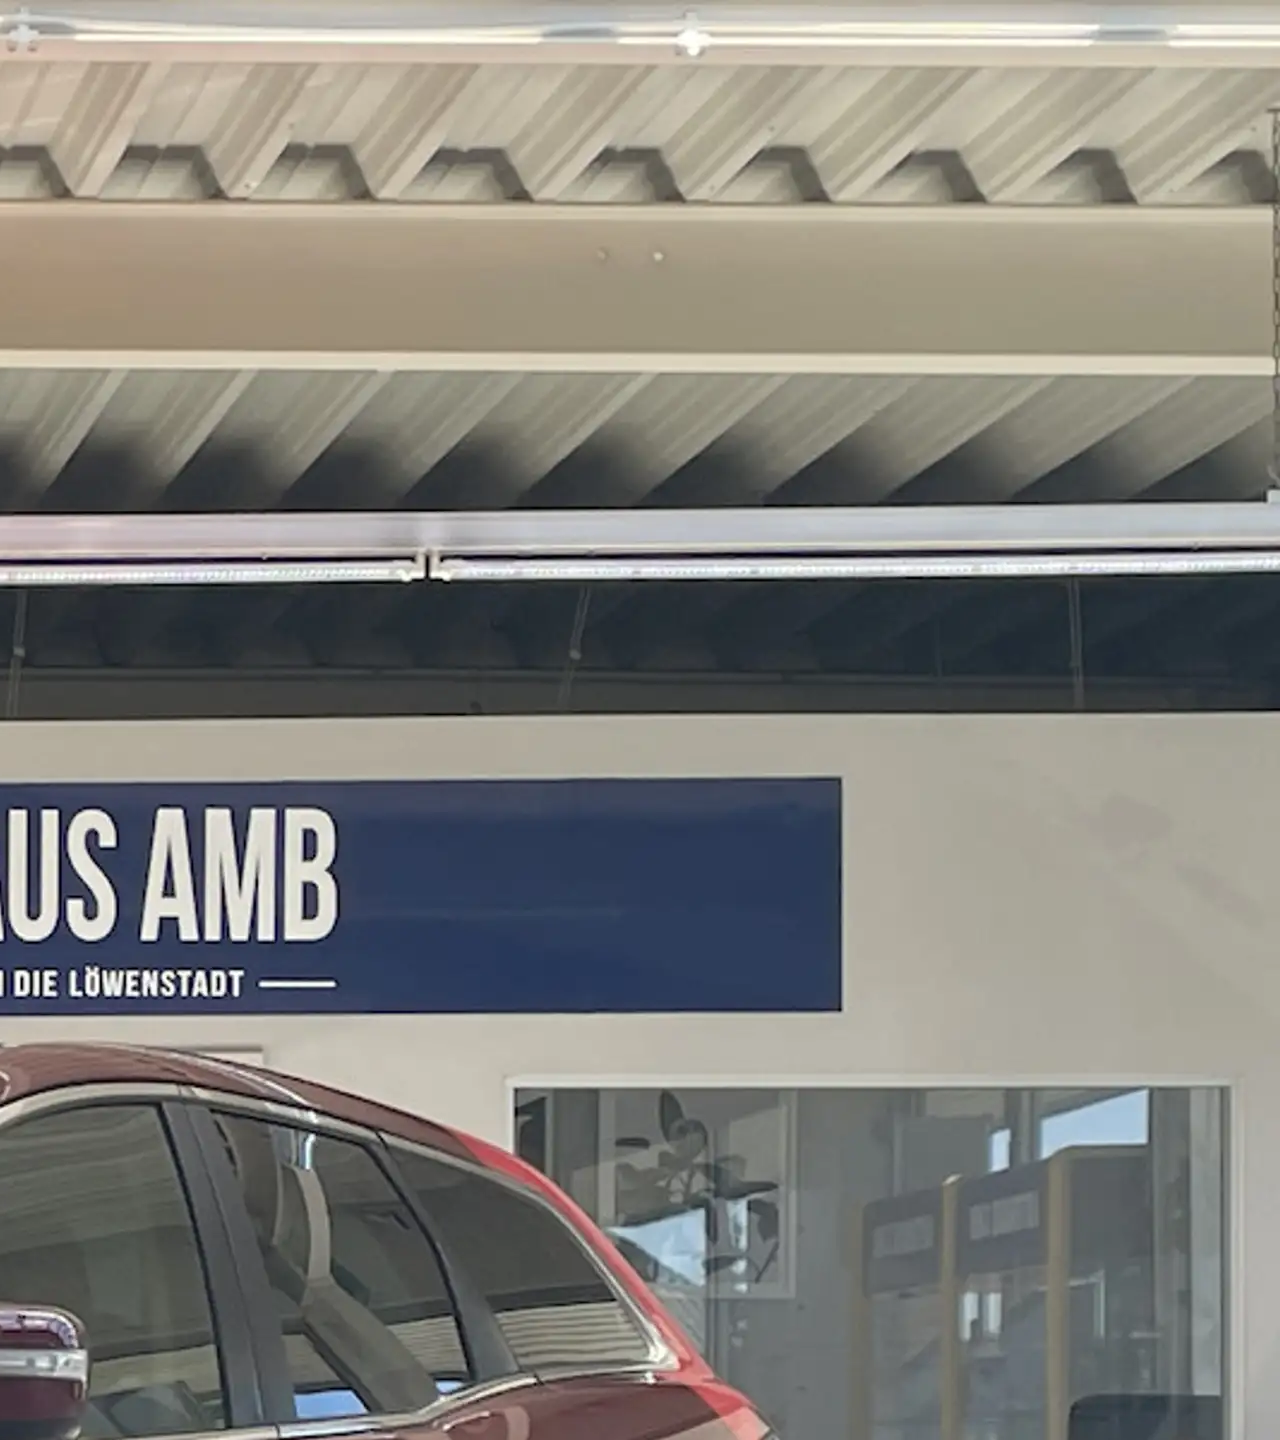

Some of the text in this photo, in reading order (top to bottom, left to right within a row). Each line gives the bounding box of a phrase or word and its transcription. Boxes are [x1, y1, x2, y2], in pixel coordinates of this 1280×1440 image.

[140, 808, 337, 942] AMB
[13, 969, 58, 998] DIE
[69, 965, 245, 998] LÖWENSTADT
